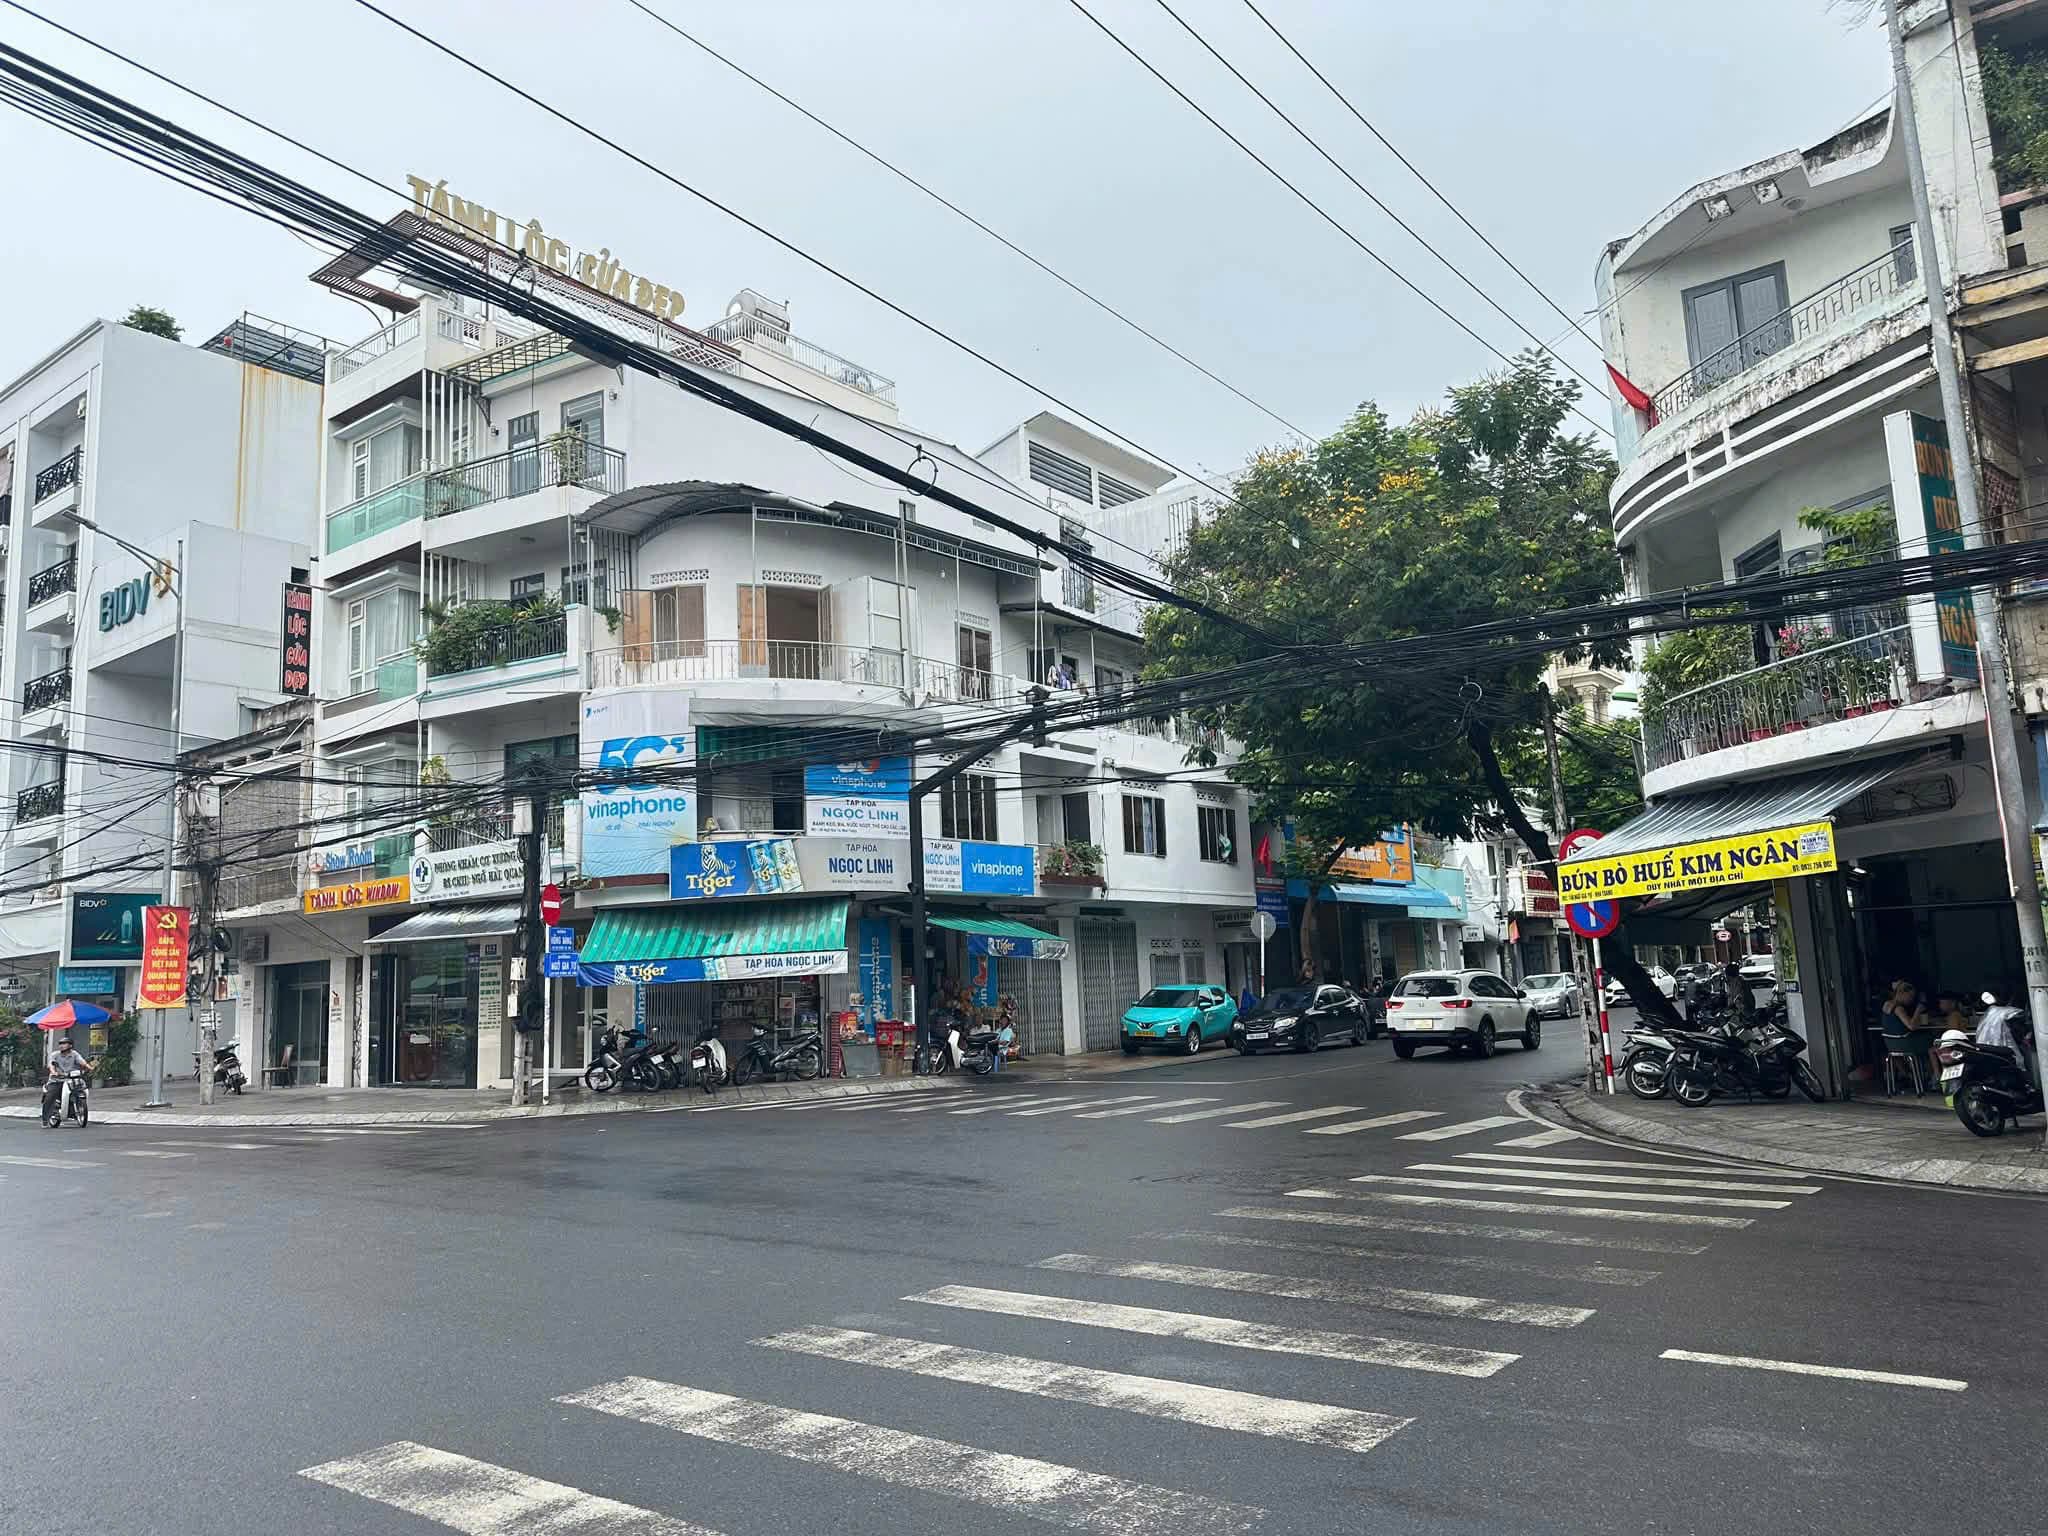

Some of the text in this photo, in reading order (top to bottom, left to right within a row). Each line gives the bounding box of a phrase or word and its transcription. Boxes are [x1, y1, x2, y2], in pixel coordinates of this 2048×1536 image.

[406, 174, 497, 248] TÁNH
[98, 571, 152, 632] BIDV
[588, 796, 687, 819] vinaphone
[822, 807, 899, 821] NGỌC LINH
[325, 847, 372, 870] Show Room
[829, 858, 894, 878] NGỌC LINH
[945, 855, 960, 866] LINH
[971, 859, 1024, 877] vinaphone
[1561, 868, 1599, 892] BÚN
[1602, 862, 1628, 887] BÒ
[1632, 850, 1675, 882] HUẾ
[1680, 852, 1723, 876] KIM
[1728, 838, 1799, 870] NGÂN
[341, 884, 363, 906] LỘC
[366, 881, 401, 901] WINDOW
[686, 872, 736, 895] Tiger
[79, 899, 99, 908] BIDV
[629, 963, 668, 981] Tiger
[786, 956, 811, 968] NGỌC
[813, 955, 834, 966] LINH
